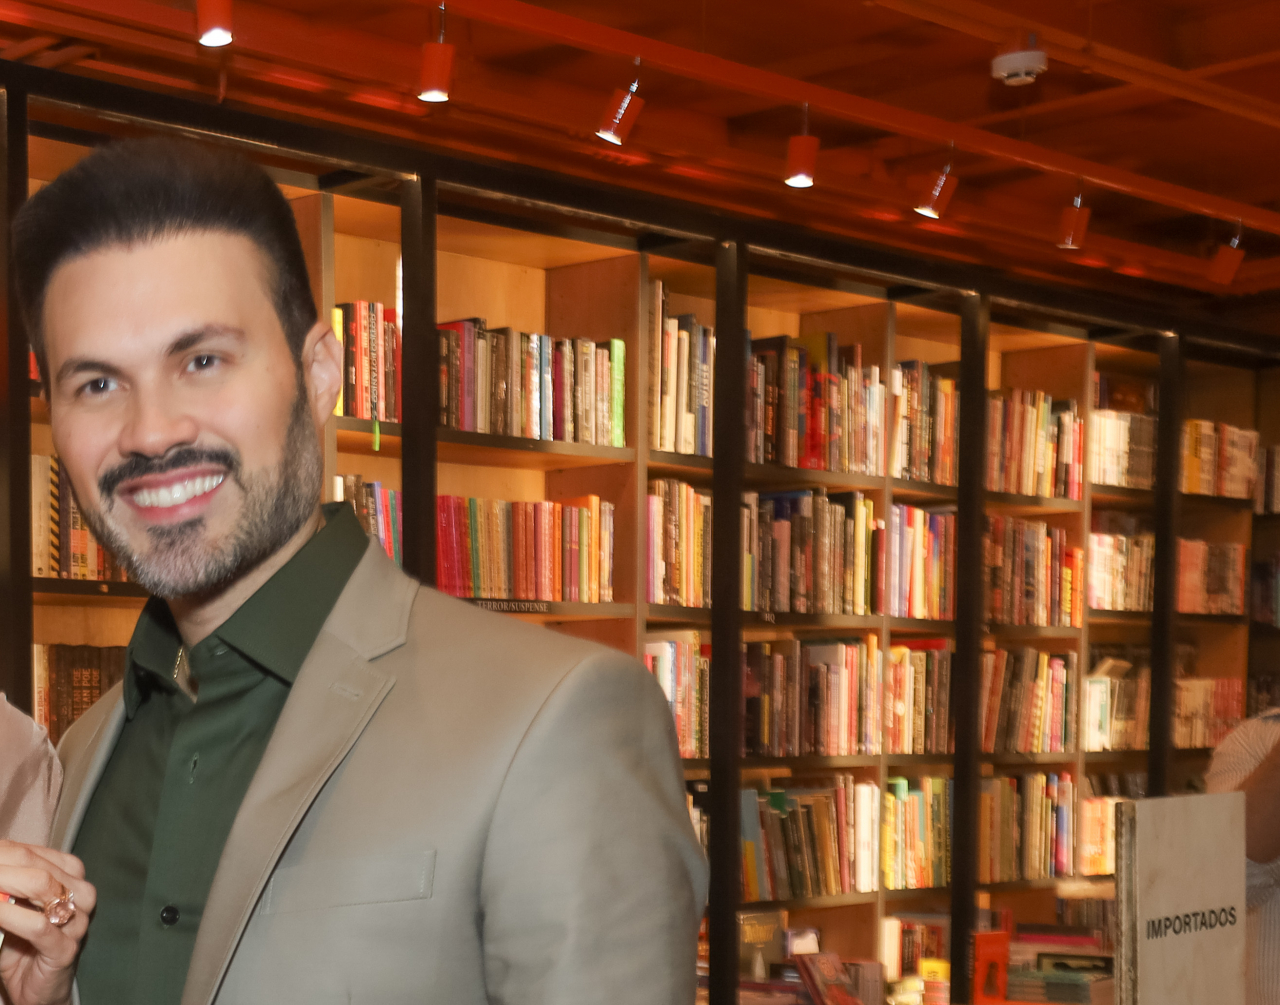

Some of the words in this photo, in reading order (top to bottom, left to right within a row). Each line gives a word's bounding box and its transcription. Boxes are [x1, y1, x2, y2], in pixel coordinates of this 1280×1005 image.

[478, 601, 548, 612] TERROR/SUSPENSE
[766, 613, 776, 624] HQ
[1146, 906, 1237, 940] IMPORTADOS
